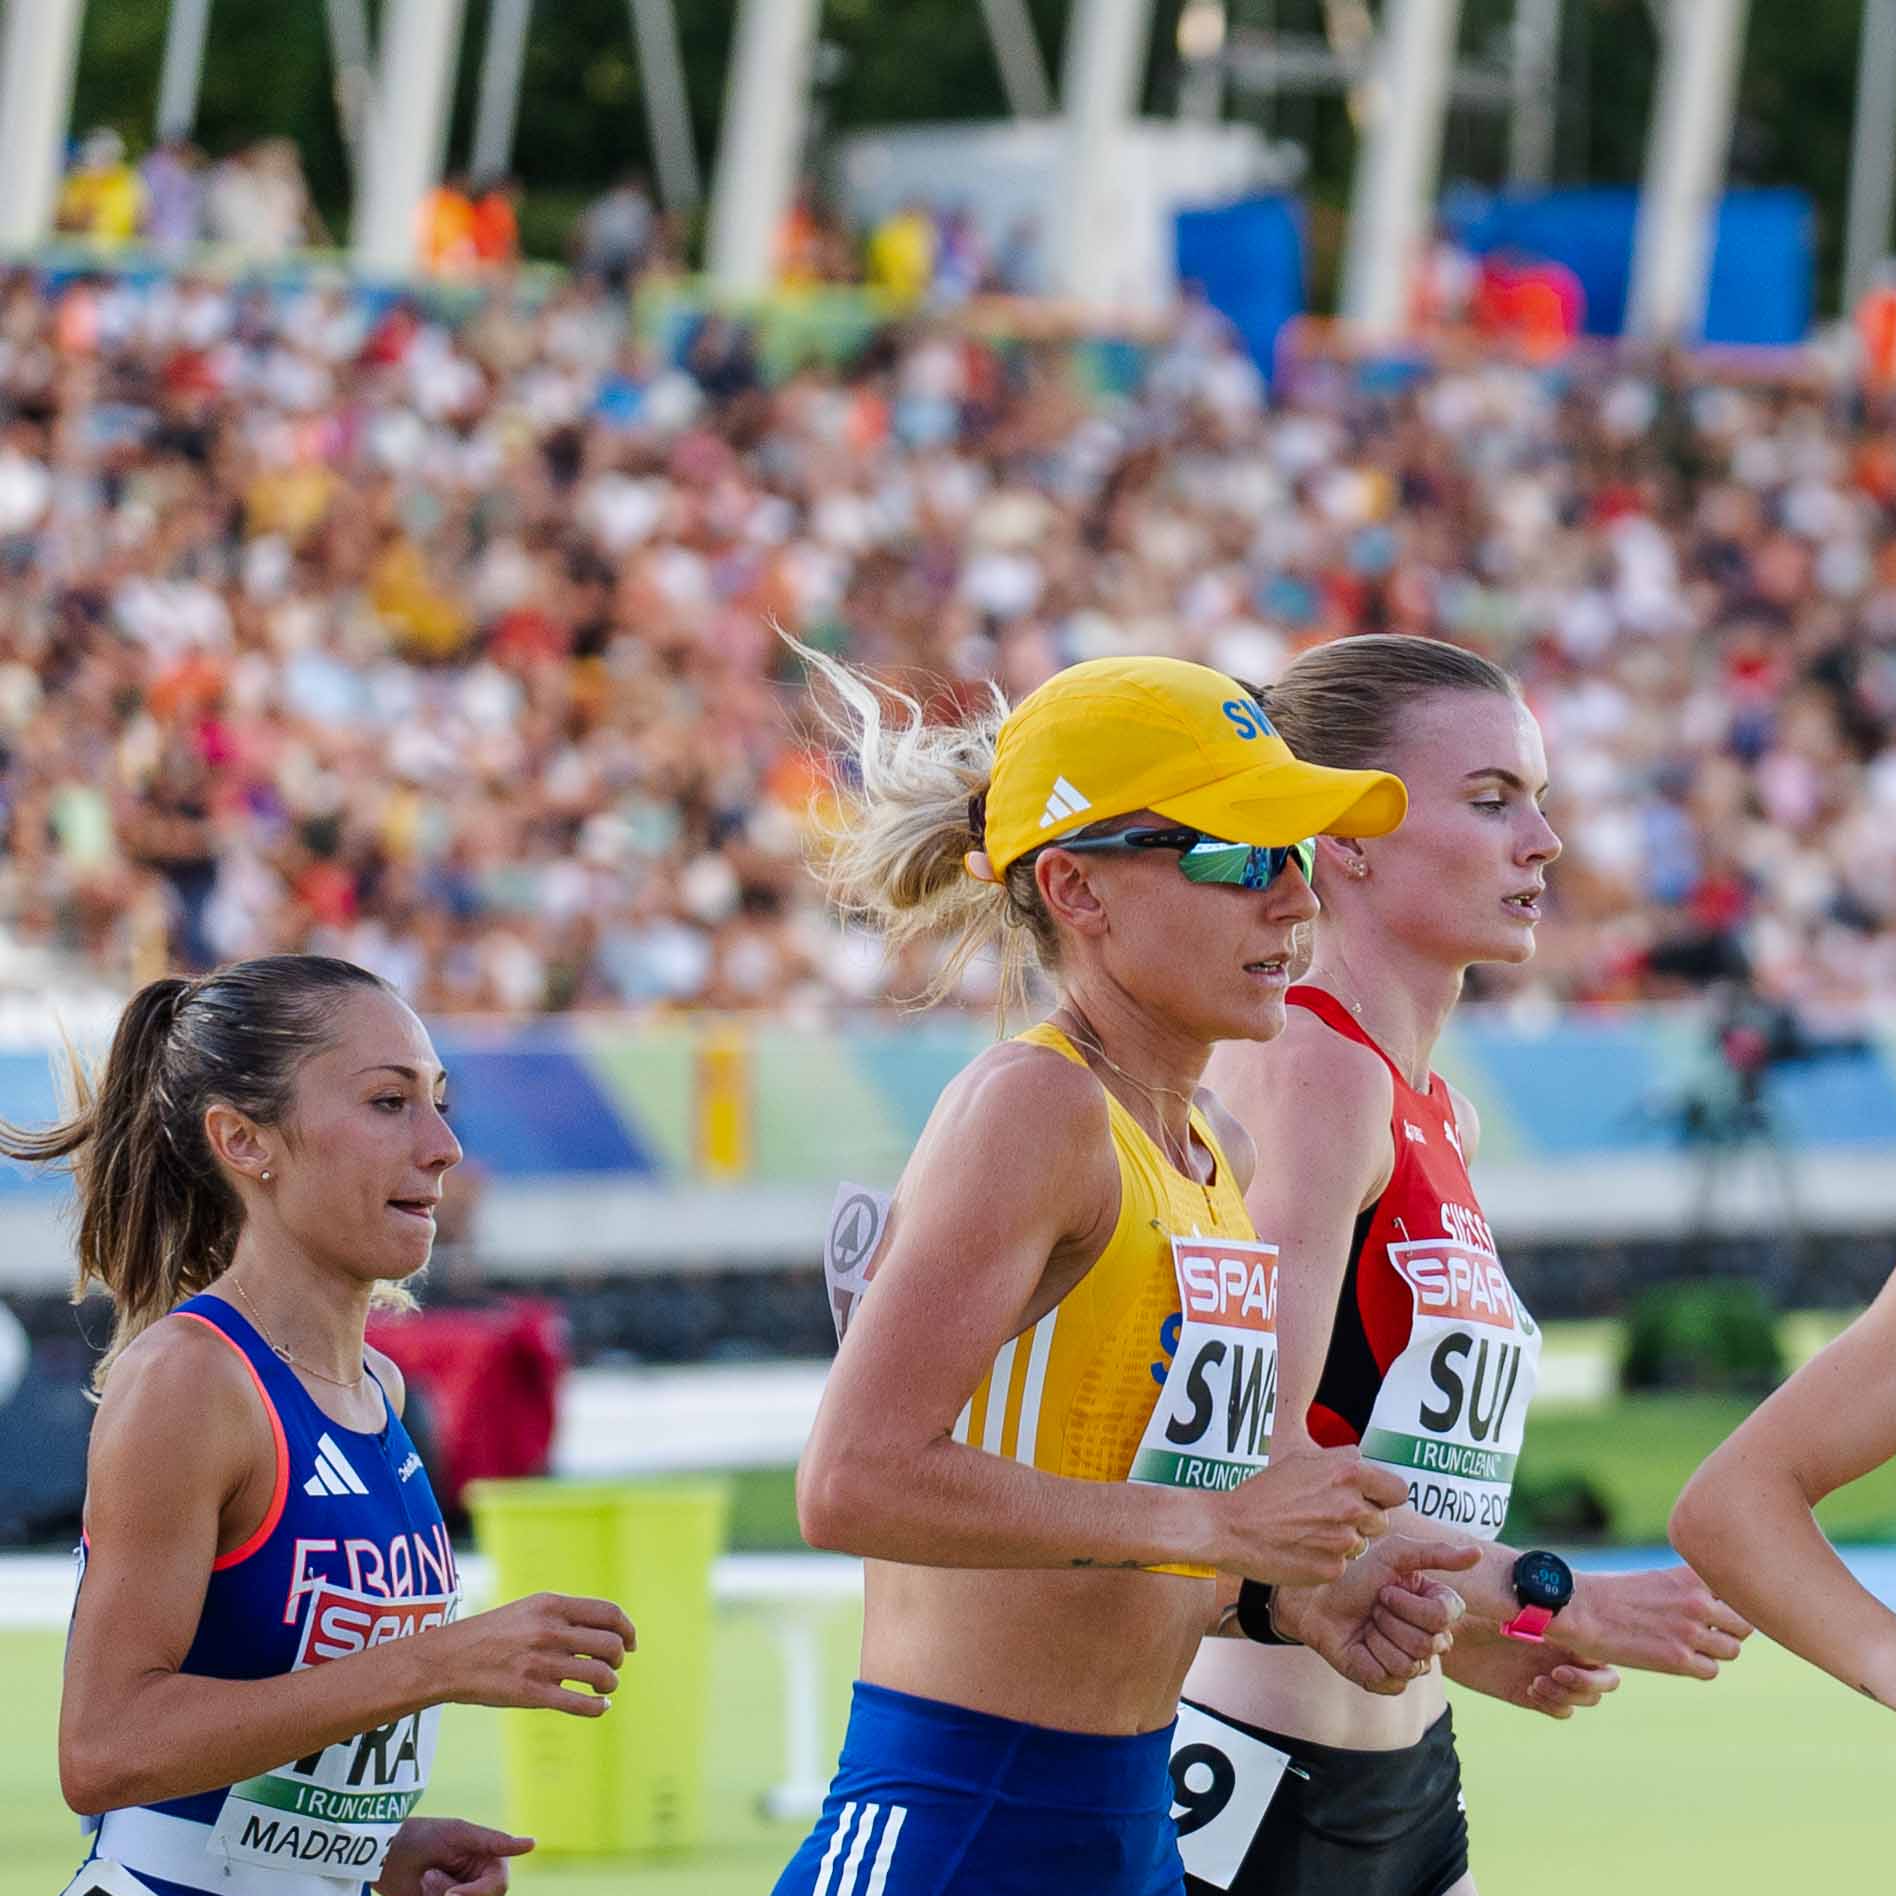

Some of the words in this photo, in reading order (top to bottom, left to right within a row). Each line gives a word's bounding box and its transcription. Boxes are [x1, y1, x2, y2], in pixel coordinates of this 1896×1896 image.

[1406, 1258, 1512, 1318] SPAR
[1419, 1332, 1521, 1443] SUI
[1186, 1459, 1227, 1489] RUN
[1423, 1443, 1462, 1472] RUN
[1408, 1481, 1476, 1522] ADRID
[296, 1786, 306, 1809] I
[308, 1790, 357, 1819] RUN
[240, 1815, 378, 1867] MADRID
